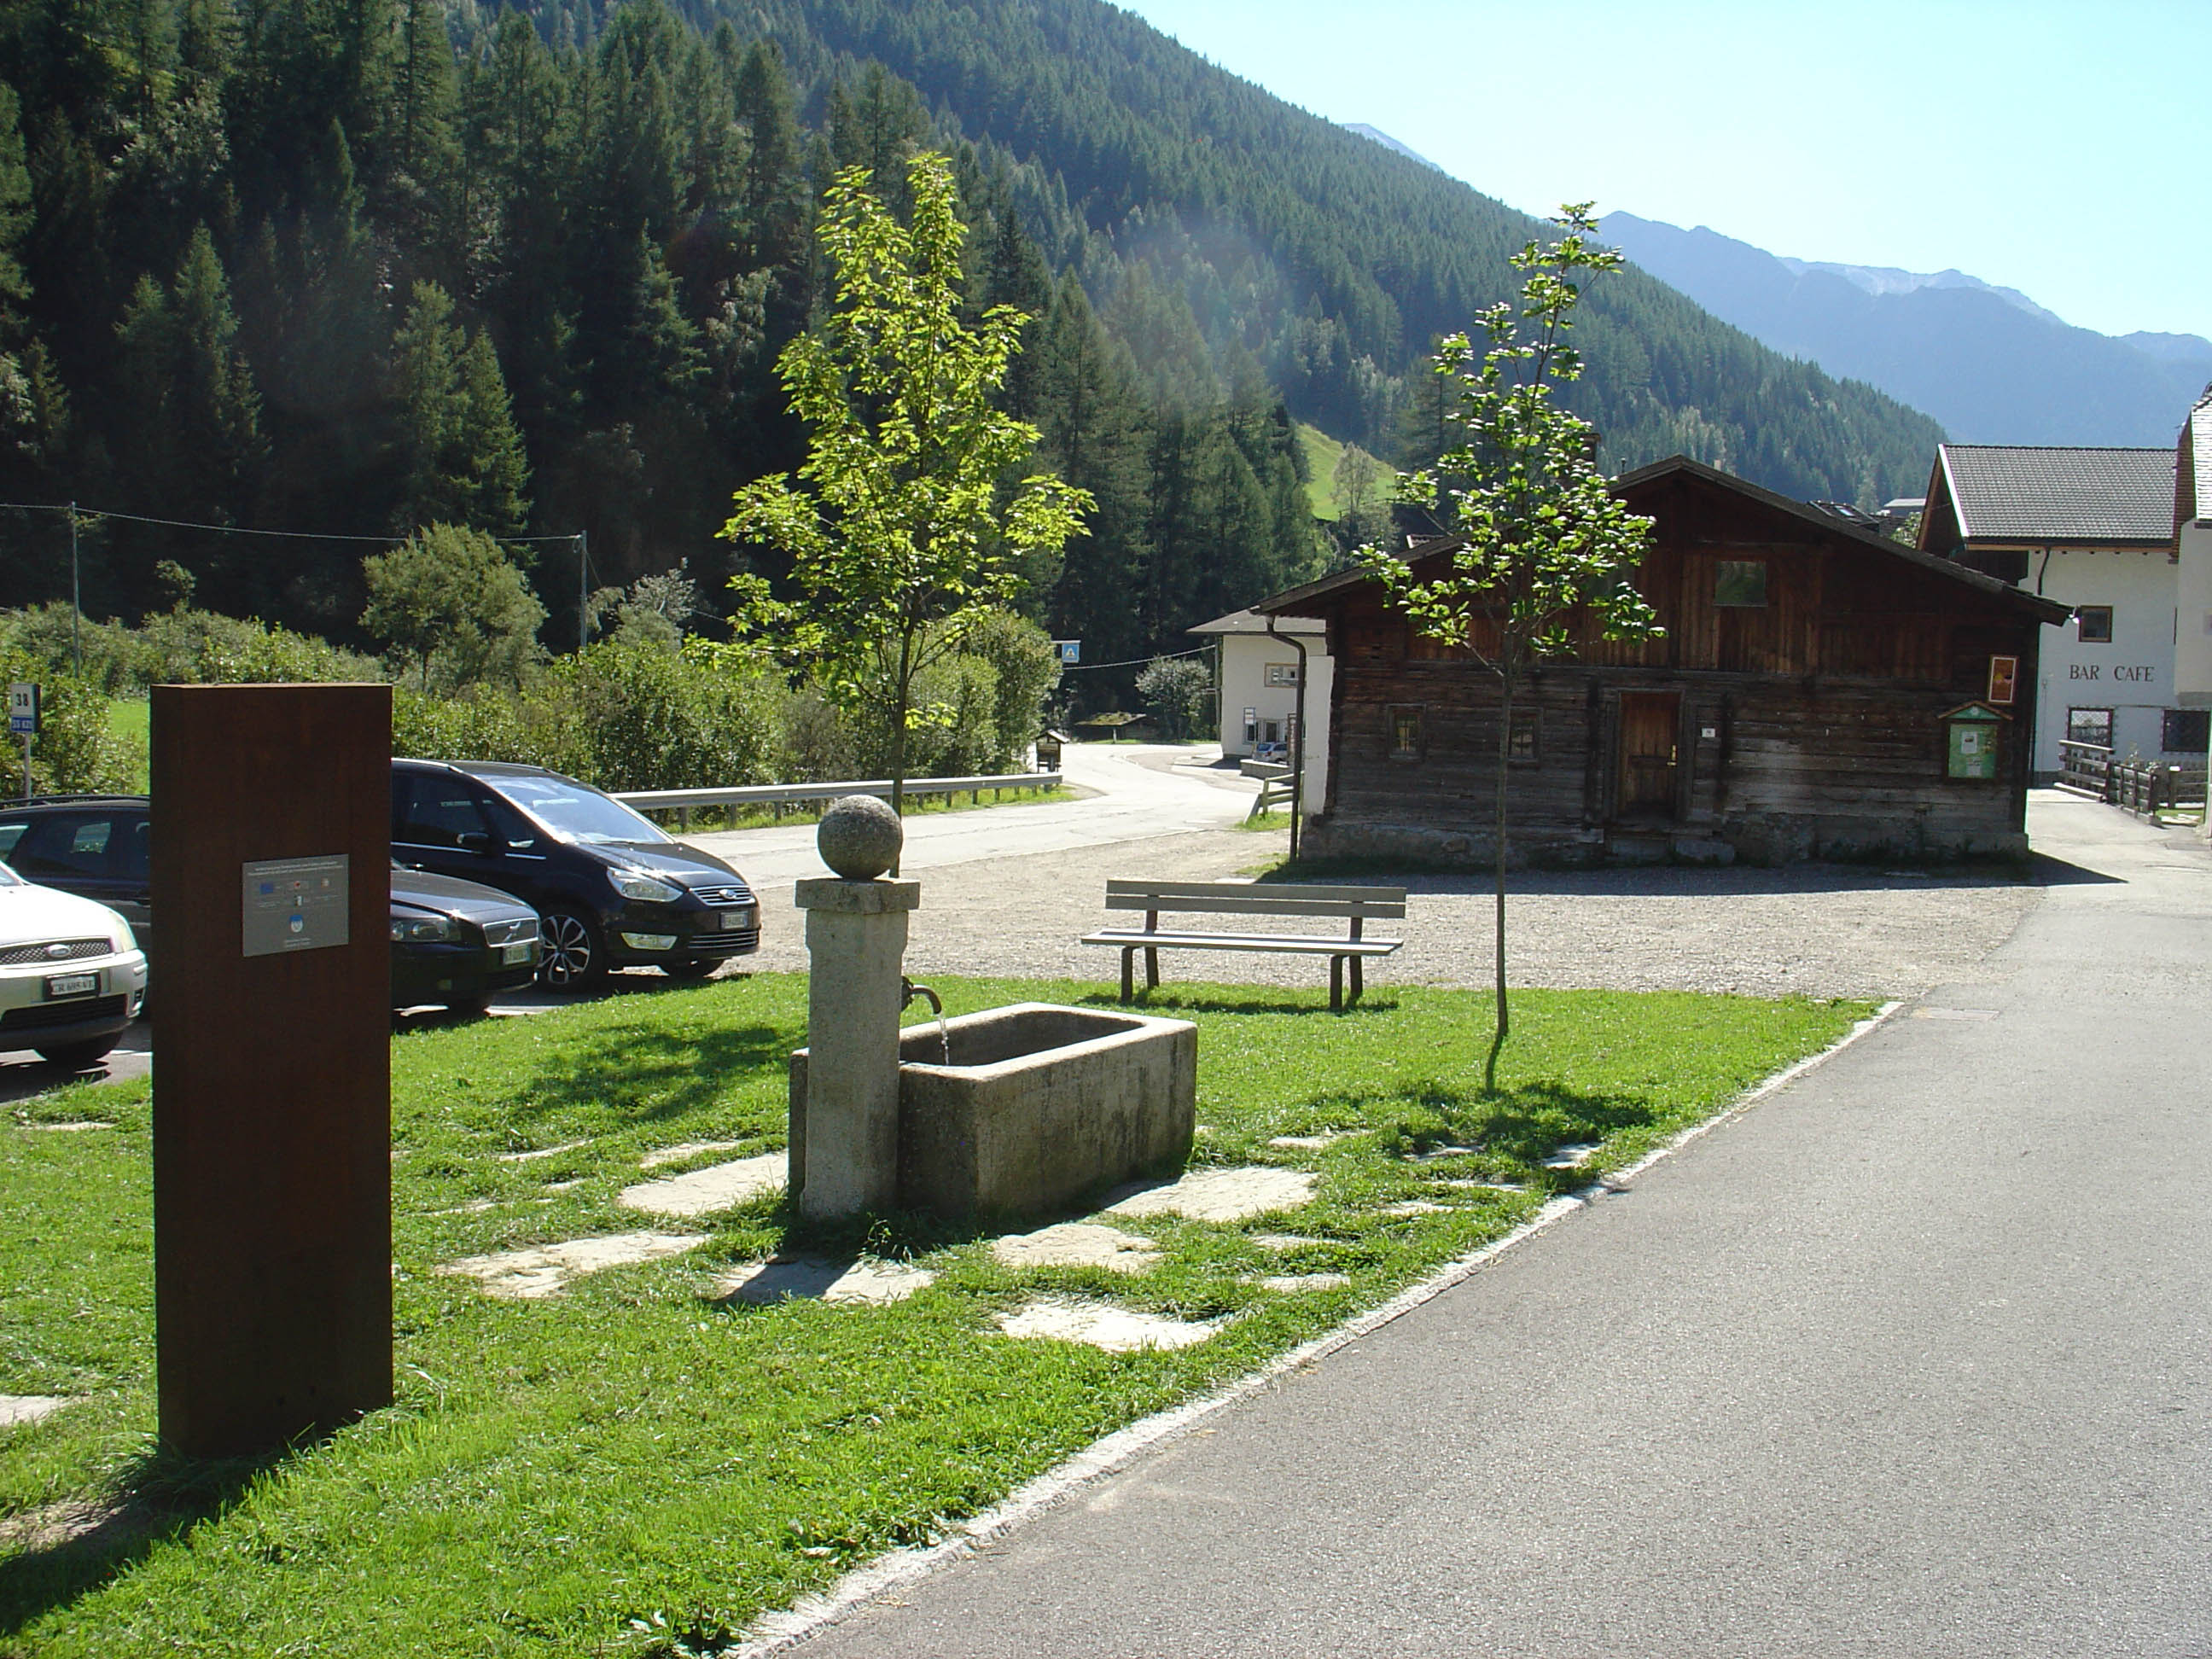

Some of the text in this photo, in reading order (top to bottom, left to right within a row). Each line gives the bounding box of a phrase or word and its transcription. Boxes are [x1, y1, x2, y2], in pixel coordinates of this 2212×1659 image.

[2069, 665, 2155, 682] BAR CAFE
[15, 693, 29, 707] 38
